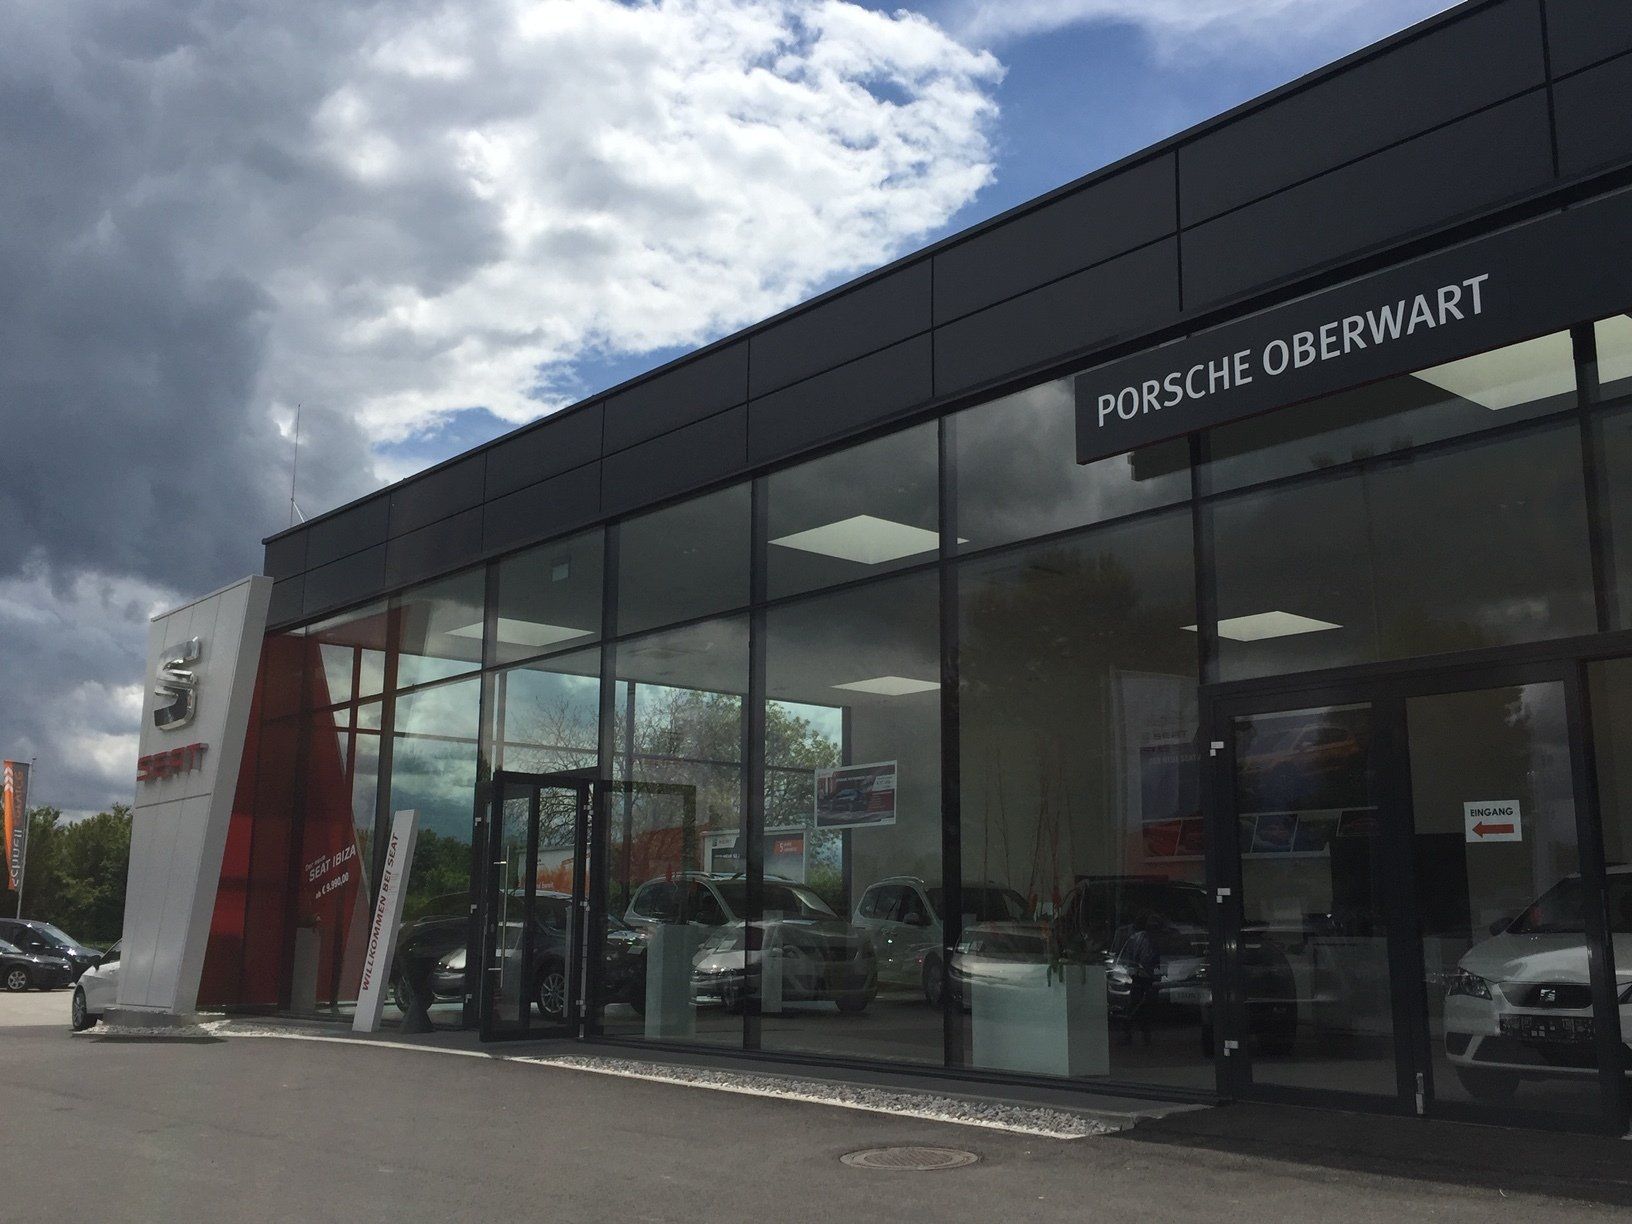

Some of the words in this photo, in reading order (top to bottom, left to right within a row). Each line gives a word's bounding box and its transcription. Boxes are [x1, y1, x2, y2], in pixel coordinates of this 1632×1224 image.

[1098, 349, 1253, 427] PORSCHE
[1263, 273, 1489, 376] OBERWART
[137, 742, 209, 784] SEAT
[1470, 806, 1514, 817] EINGANG
[309, 858, 331, 882] SEAT
[332, 844, 357, 868] IBIZA
[387, 832, 399, 868] SEAT
[383, 871, 392, 892] BEI
[362, 896, 387, 991] WILLKOMMEN
